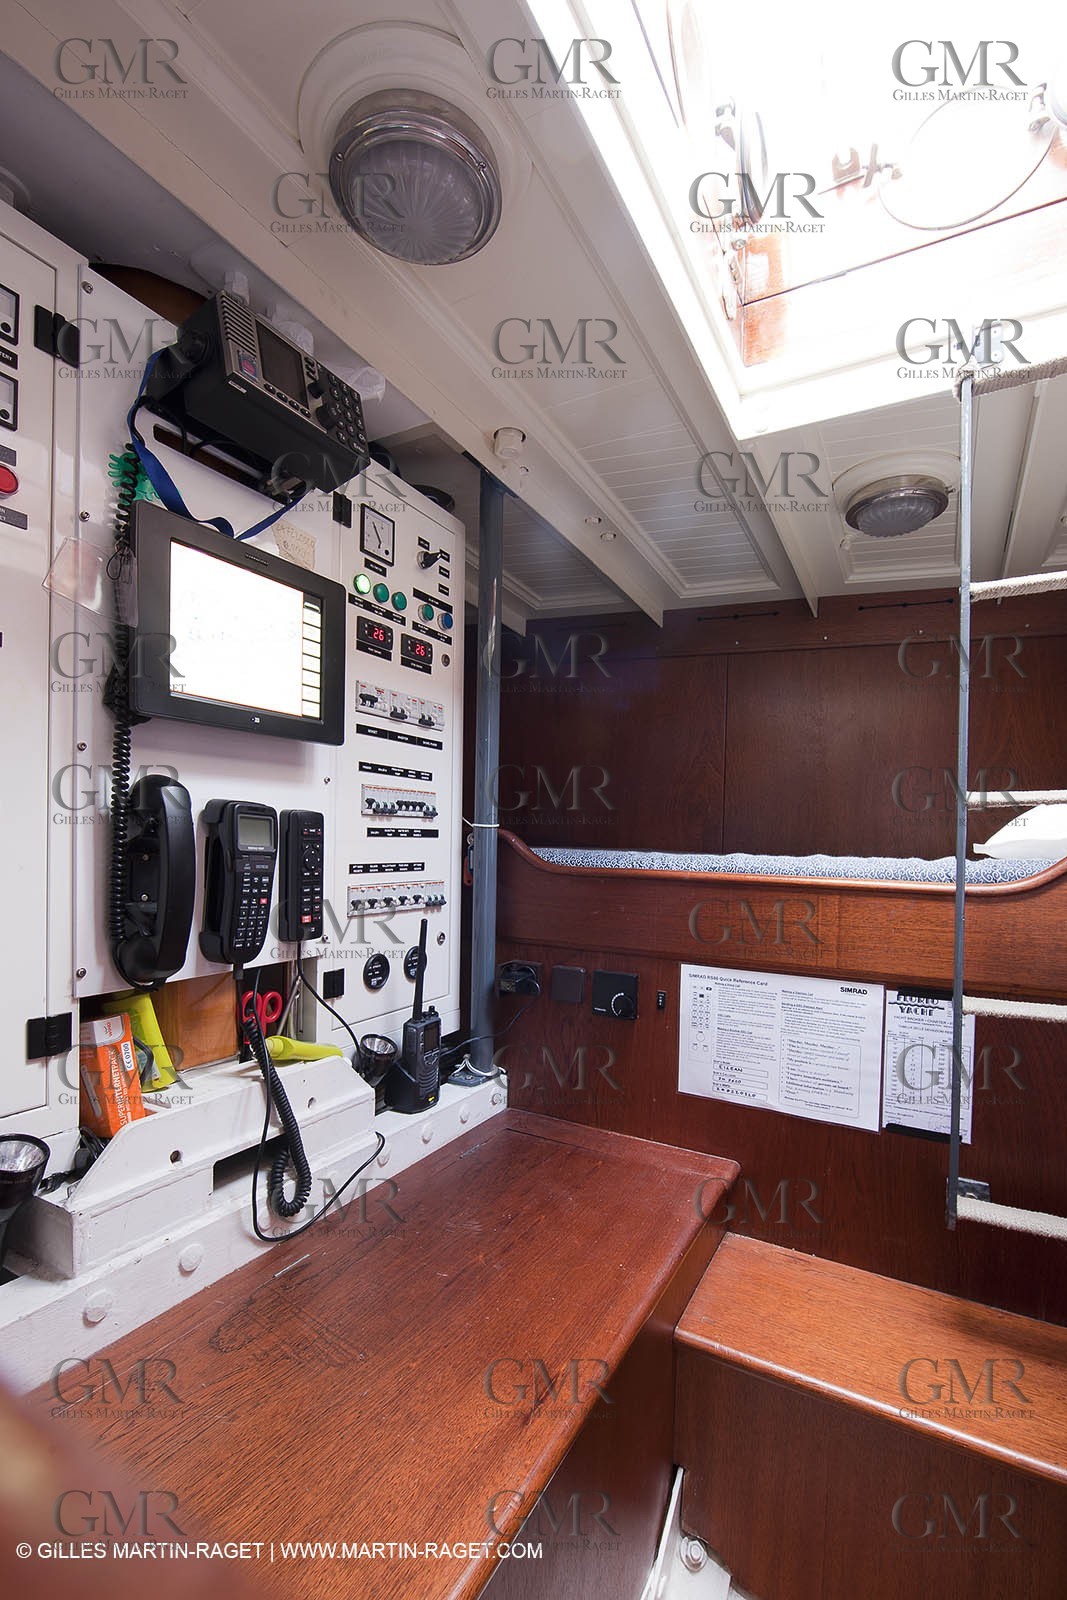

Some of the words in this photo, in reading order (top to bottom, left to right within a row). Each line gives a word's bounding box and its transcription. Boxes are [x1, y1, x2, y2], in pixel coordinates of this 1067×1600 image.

[372, 627, 385, 642] 26
[415, 644, 426, 657] 26
[840, 986, 868, 995] SIMRAD
